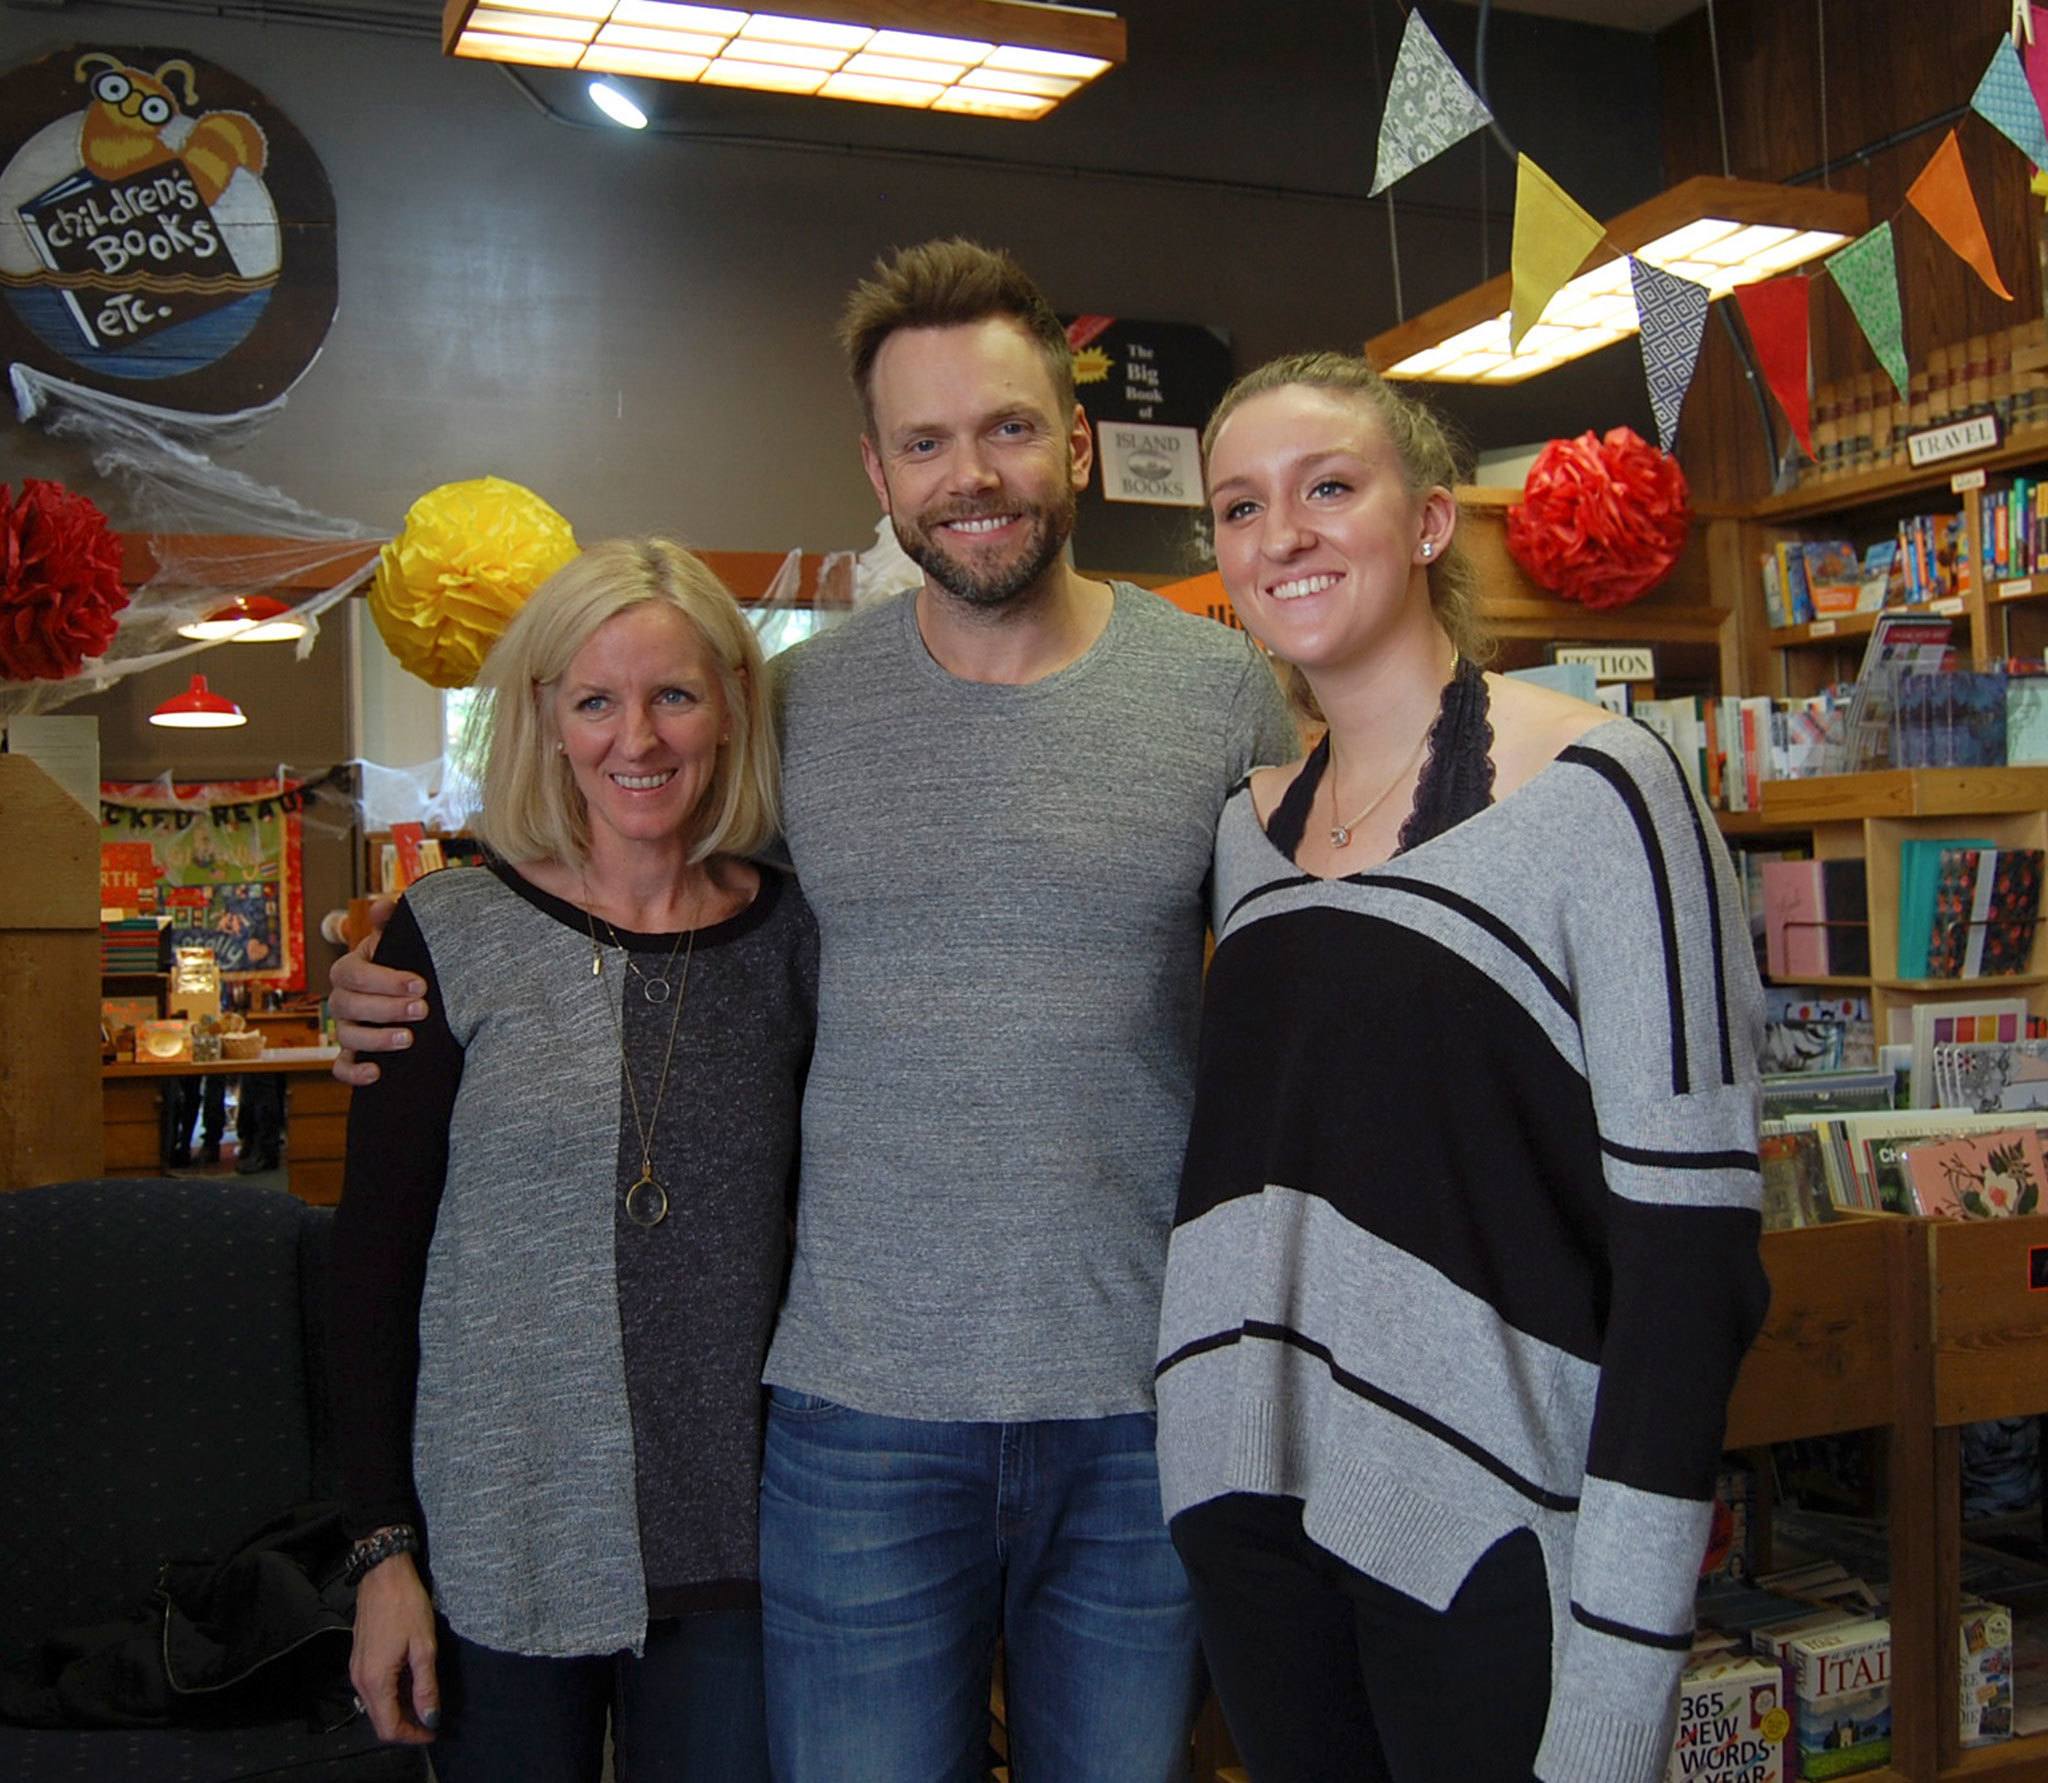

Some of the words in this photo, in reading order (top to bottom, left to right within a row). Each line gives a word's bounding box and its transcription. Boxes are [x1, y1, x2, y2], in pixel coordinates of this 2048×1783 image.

[1127, 344, 1155, 359] The
[1127, 363, 1160, 386] Big
[1125, 385, 1165, 403] Book
[1138, 406, 1153, 419] of
[1115, 432, 1181, 451] ISLAND
[1913, 423, 1993, 458] TRAVEL
[1122, 478, 1185, 497] BOOKS
[1816, 1648, 1890, 1696] ITAL
[1680, 1692, 1724, 1721] 365
[1680, 1716, 1739, 1747] NEW
